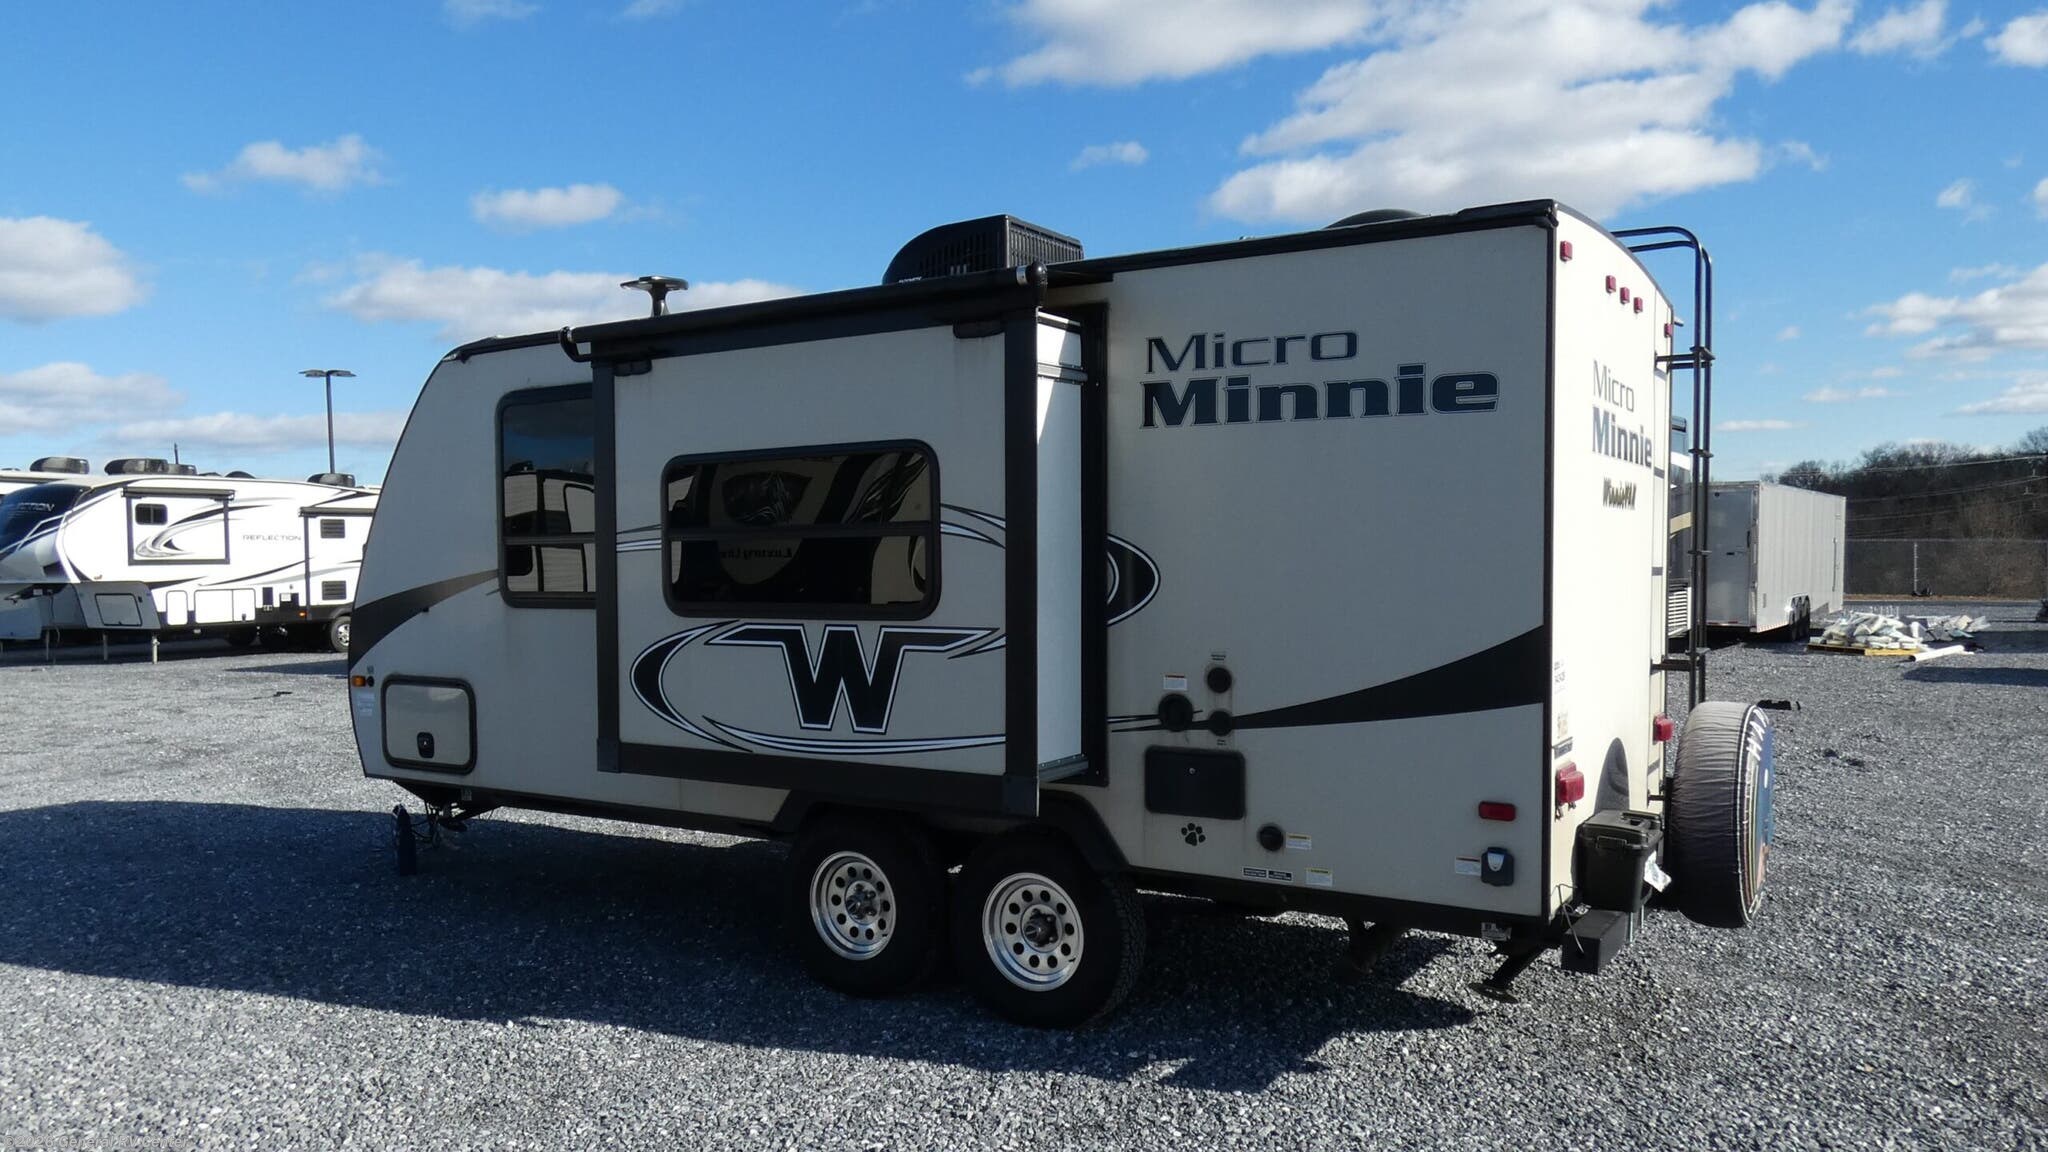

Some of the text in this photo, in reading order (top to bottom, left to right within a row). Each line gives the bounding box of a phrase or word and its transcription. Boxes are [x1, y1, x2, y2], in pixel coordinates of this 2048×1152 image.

[1145, 331, 1359, 374] Micro
[1140, 362, 1500, 429] Minnie
[1593, 358, 1635, 413] Micro
[1592, 404, 1653, 469] Minnie
